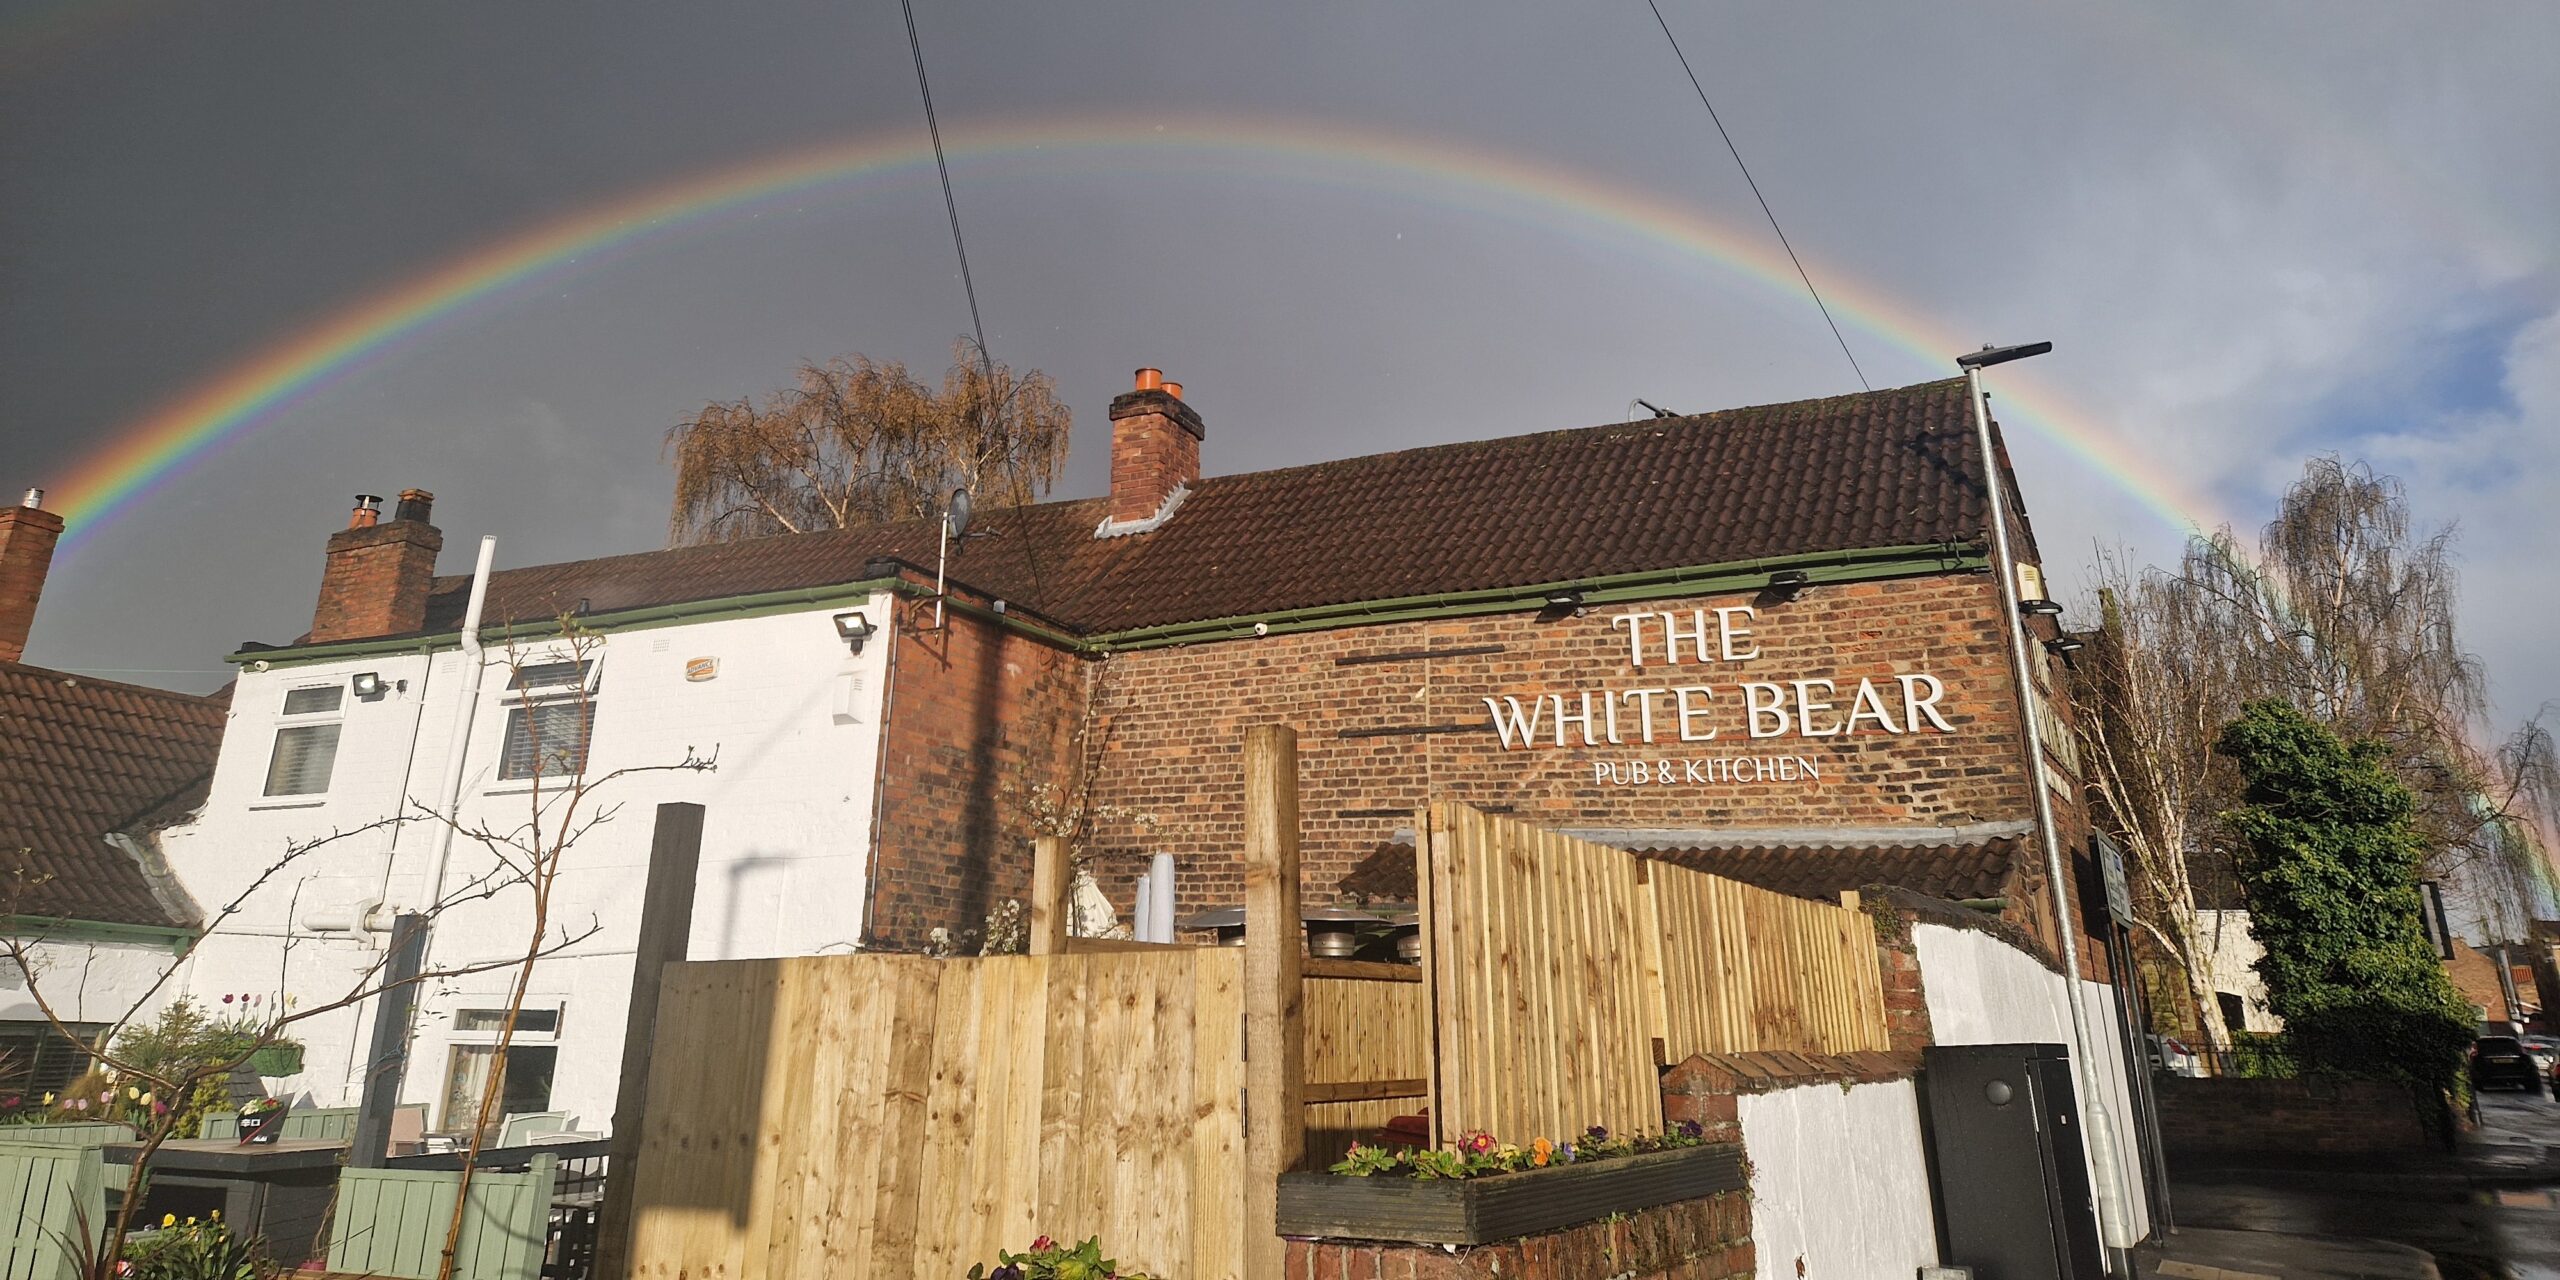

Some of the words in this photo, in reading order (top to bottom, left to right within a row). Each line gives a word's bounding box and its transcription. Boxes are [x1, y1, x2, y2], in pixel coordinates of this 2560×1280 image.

[1612, 606, 1760, 667] THE
[1482, 685, 1718, 750] WHITE
[1739, 673, 1957, 739] BEAR
[1594, 760, 1650, 786] PUB
[1657, 759, 1677, 784] &
[1684, 755, 1820, 783] KITCHEN
